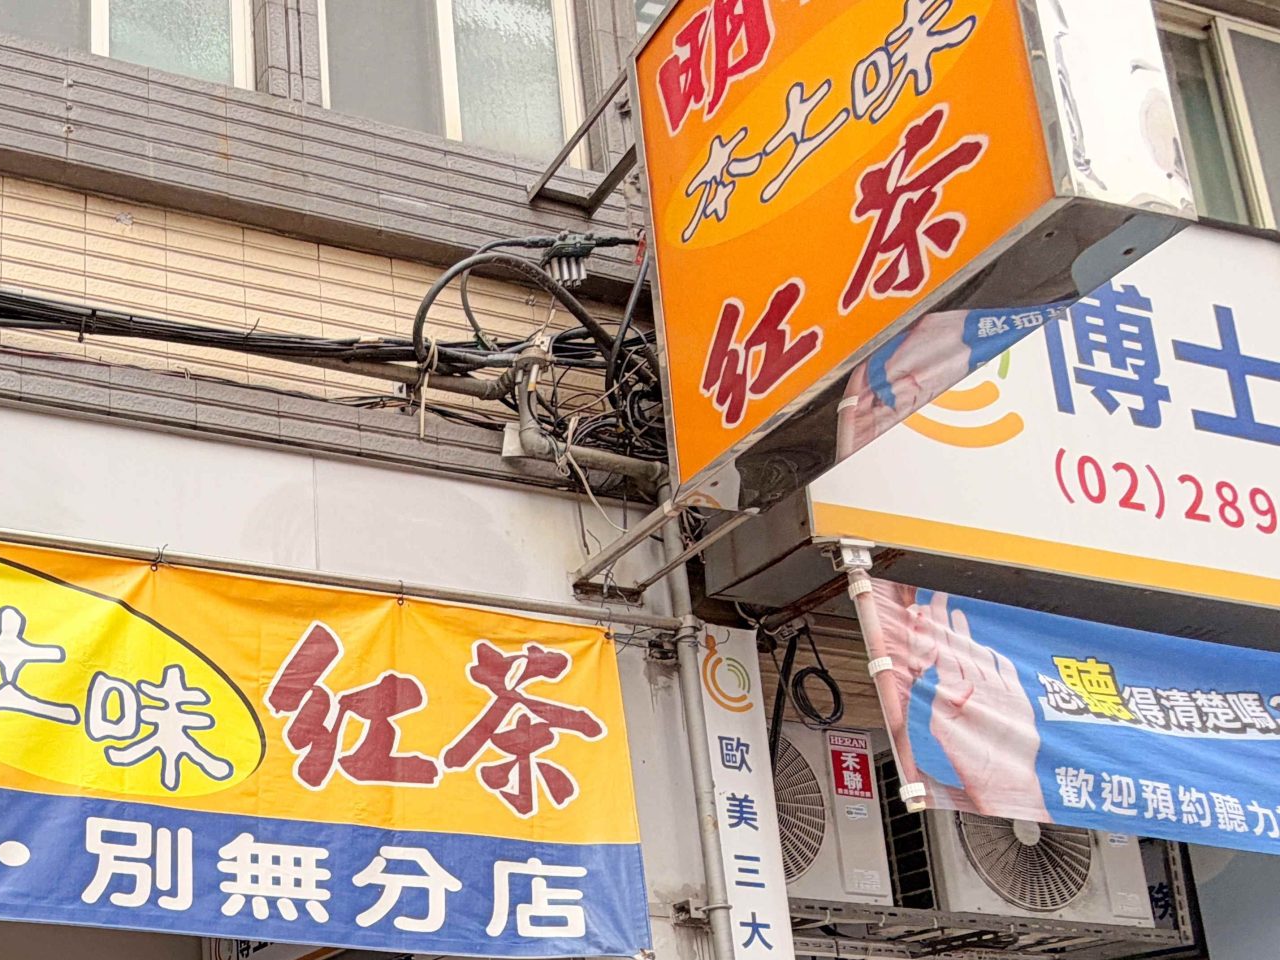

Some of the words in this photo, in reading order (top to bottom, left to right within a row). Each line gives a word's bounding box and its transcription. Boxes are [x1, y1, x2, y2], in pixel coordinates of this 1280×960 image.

[683, 0, 976, 243] 本土味
[830, 736, 867, 748] HERAN
[840, 752, 863, 791] 禾聯
[1055, 766, 1280, 839] 歡迎預約聽力
